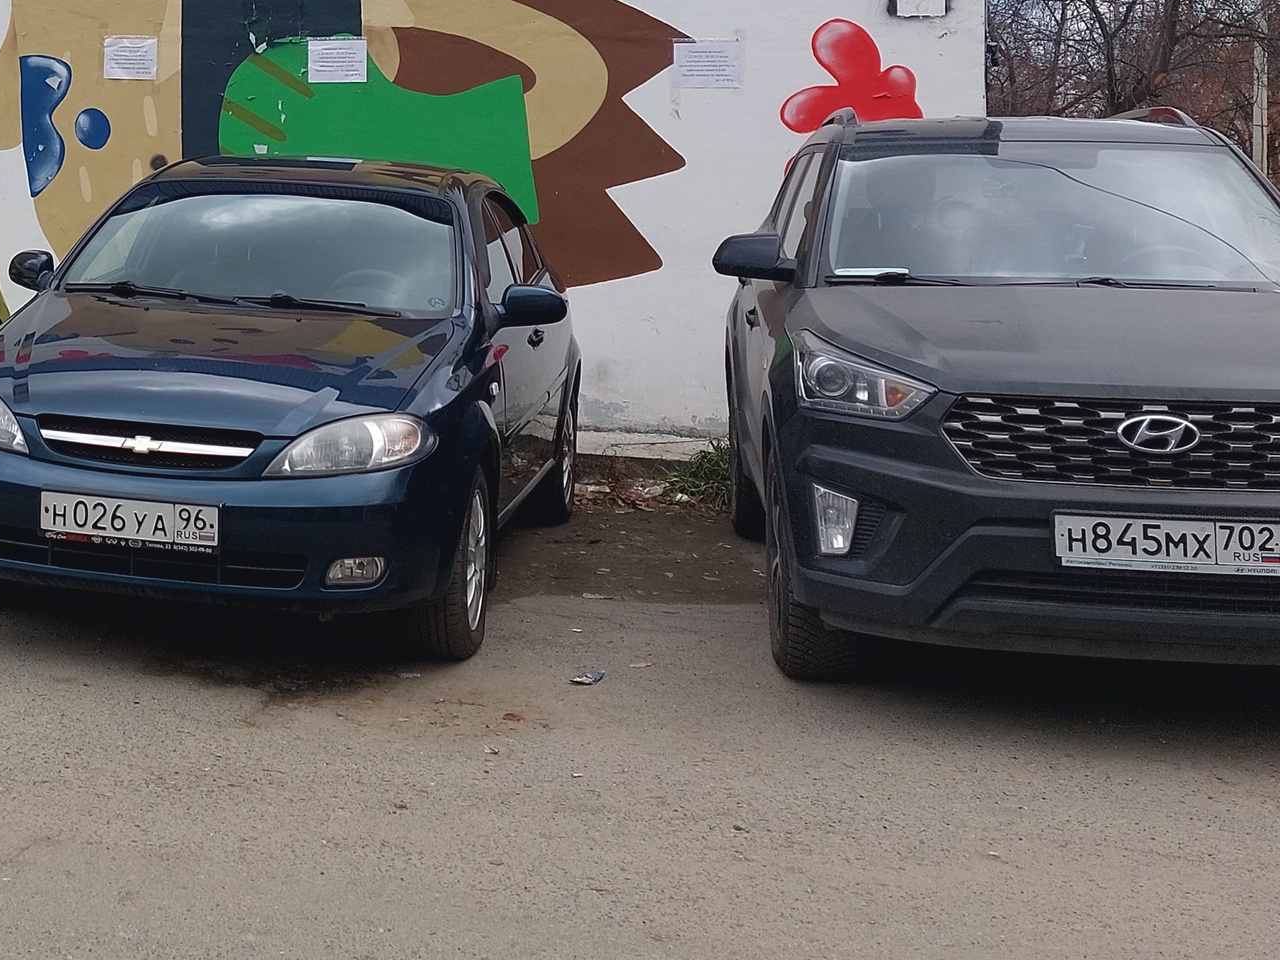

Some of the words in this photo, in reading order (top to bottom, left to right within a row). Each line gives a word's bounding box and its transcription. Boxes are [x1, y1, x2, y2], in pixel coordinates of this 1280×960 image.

[178, 507, 207, 531] 96
[176, 530, 198, 540] RUS
[1067, 522, 1212, 559] Н845МХ
[1219, 525, 1275, 552] 702
[1233, 552, 1260, 562] RUS
